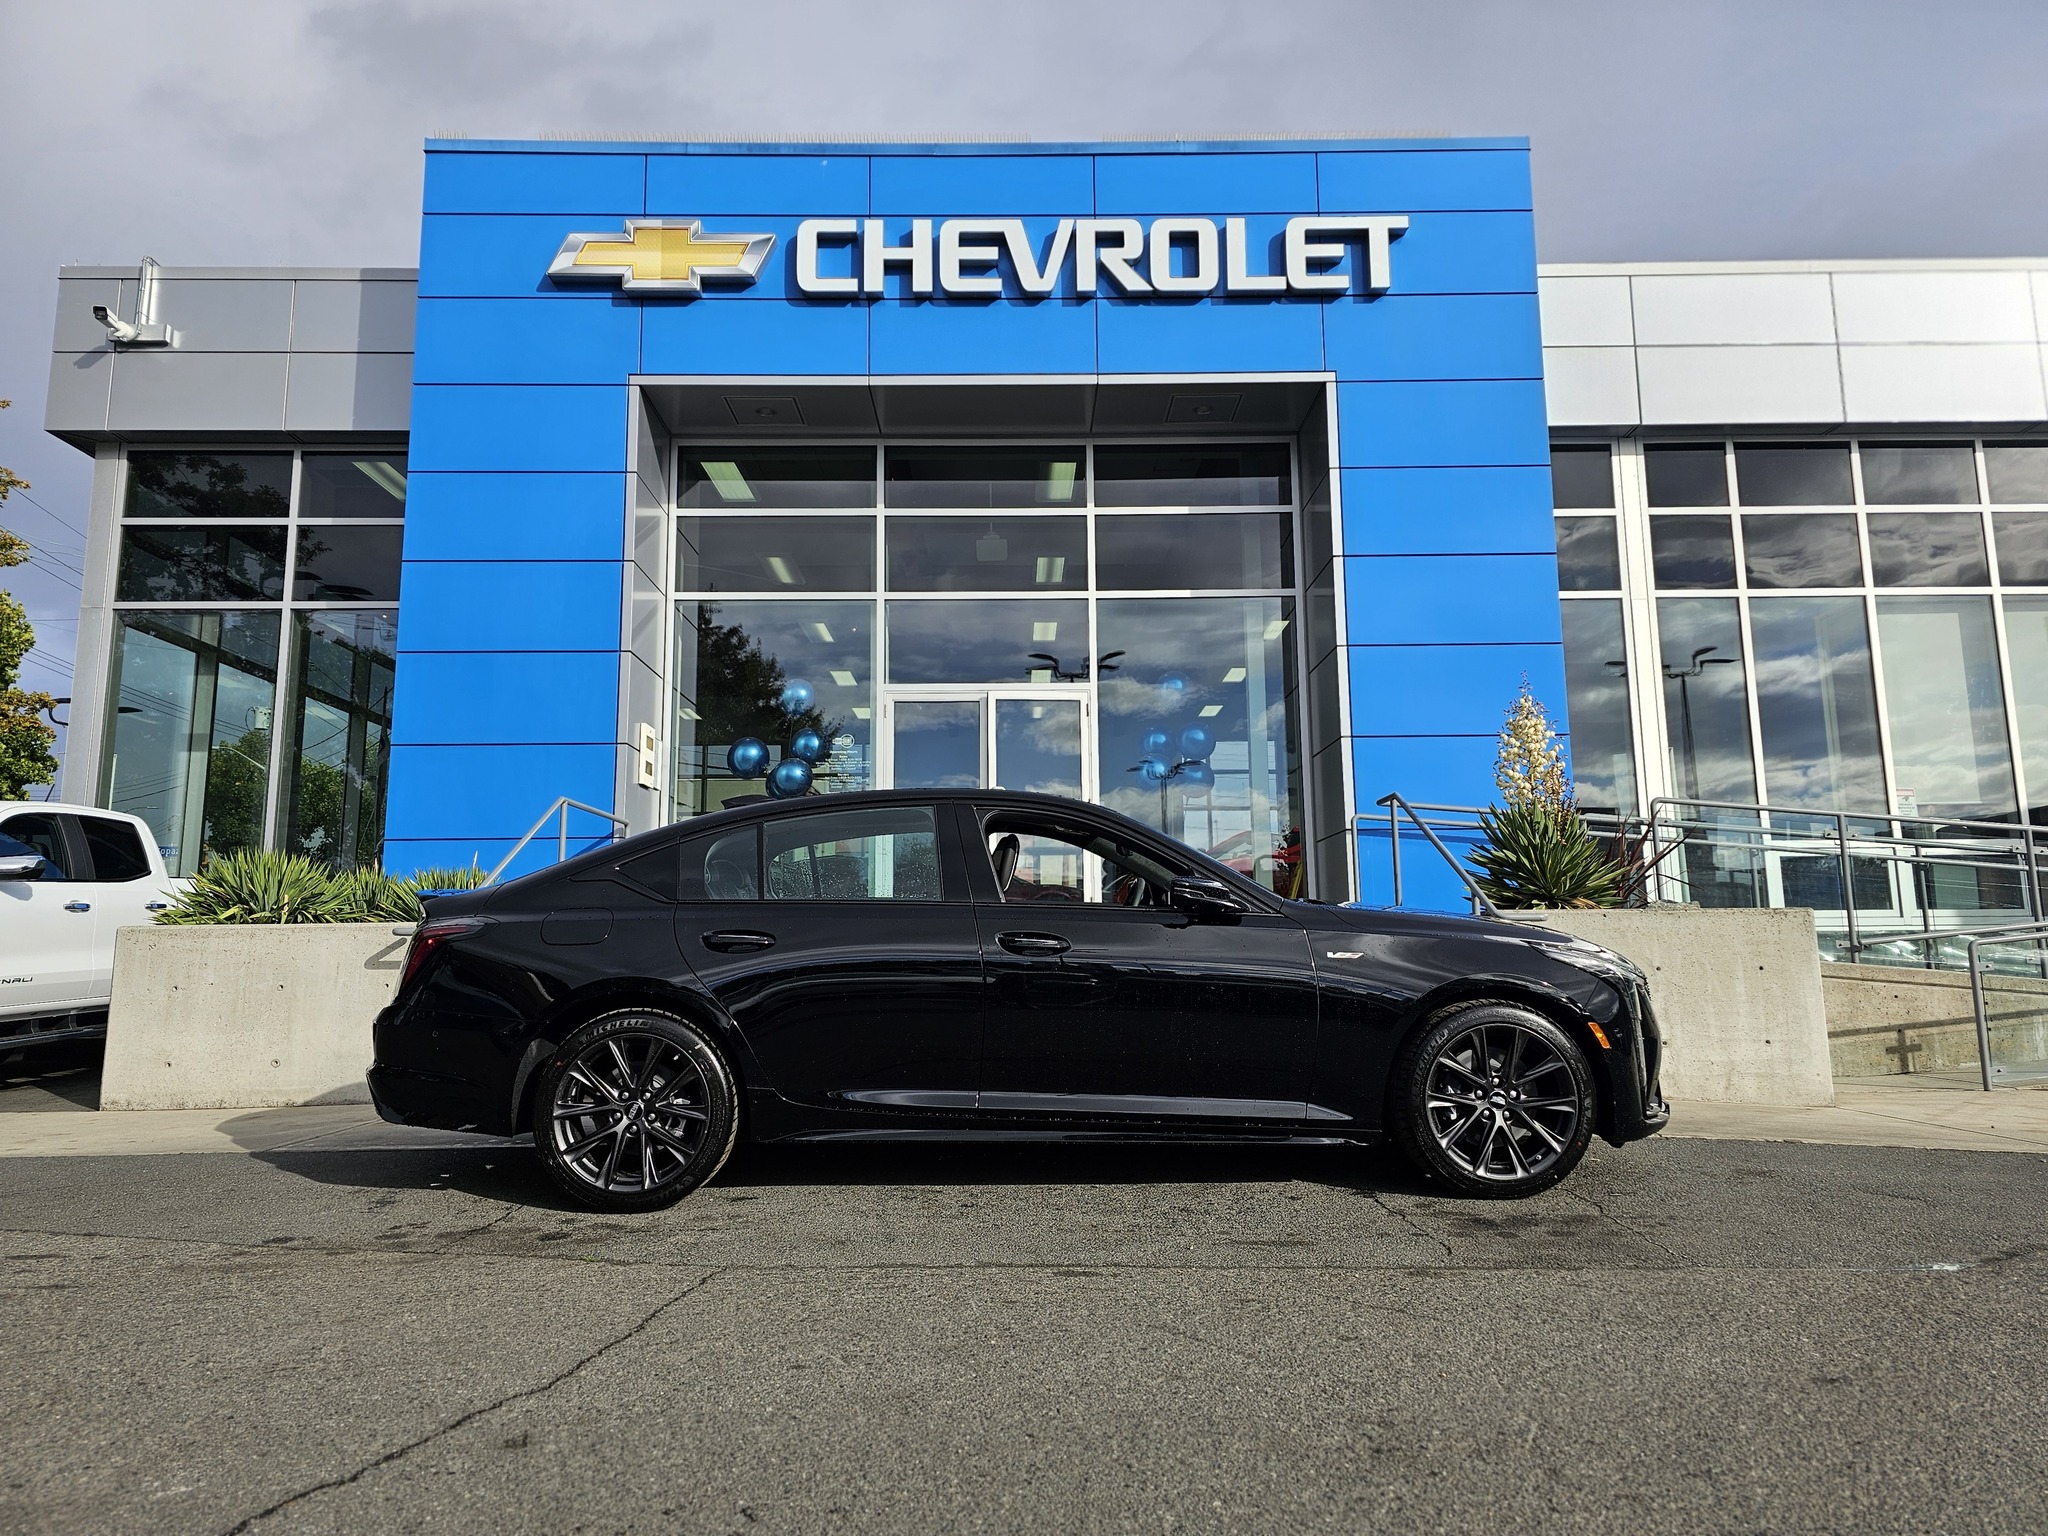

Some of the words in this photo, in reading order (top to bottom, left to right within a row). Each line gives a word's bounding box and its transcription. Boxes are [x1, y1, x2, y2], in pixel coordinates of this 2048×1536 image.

[796, 216, 1409, 294] CHEVROLET
[159, 848, 179, 857] opaz
[0, 976, 33, 984] NALI
[584, 1019, 650, 1041] MICHELIN
